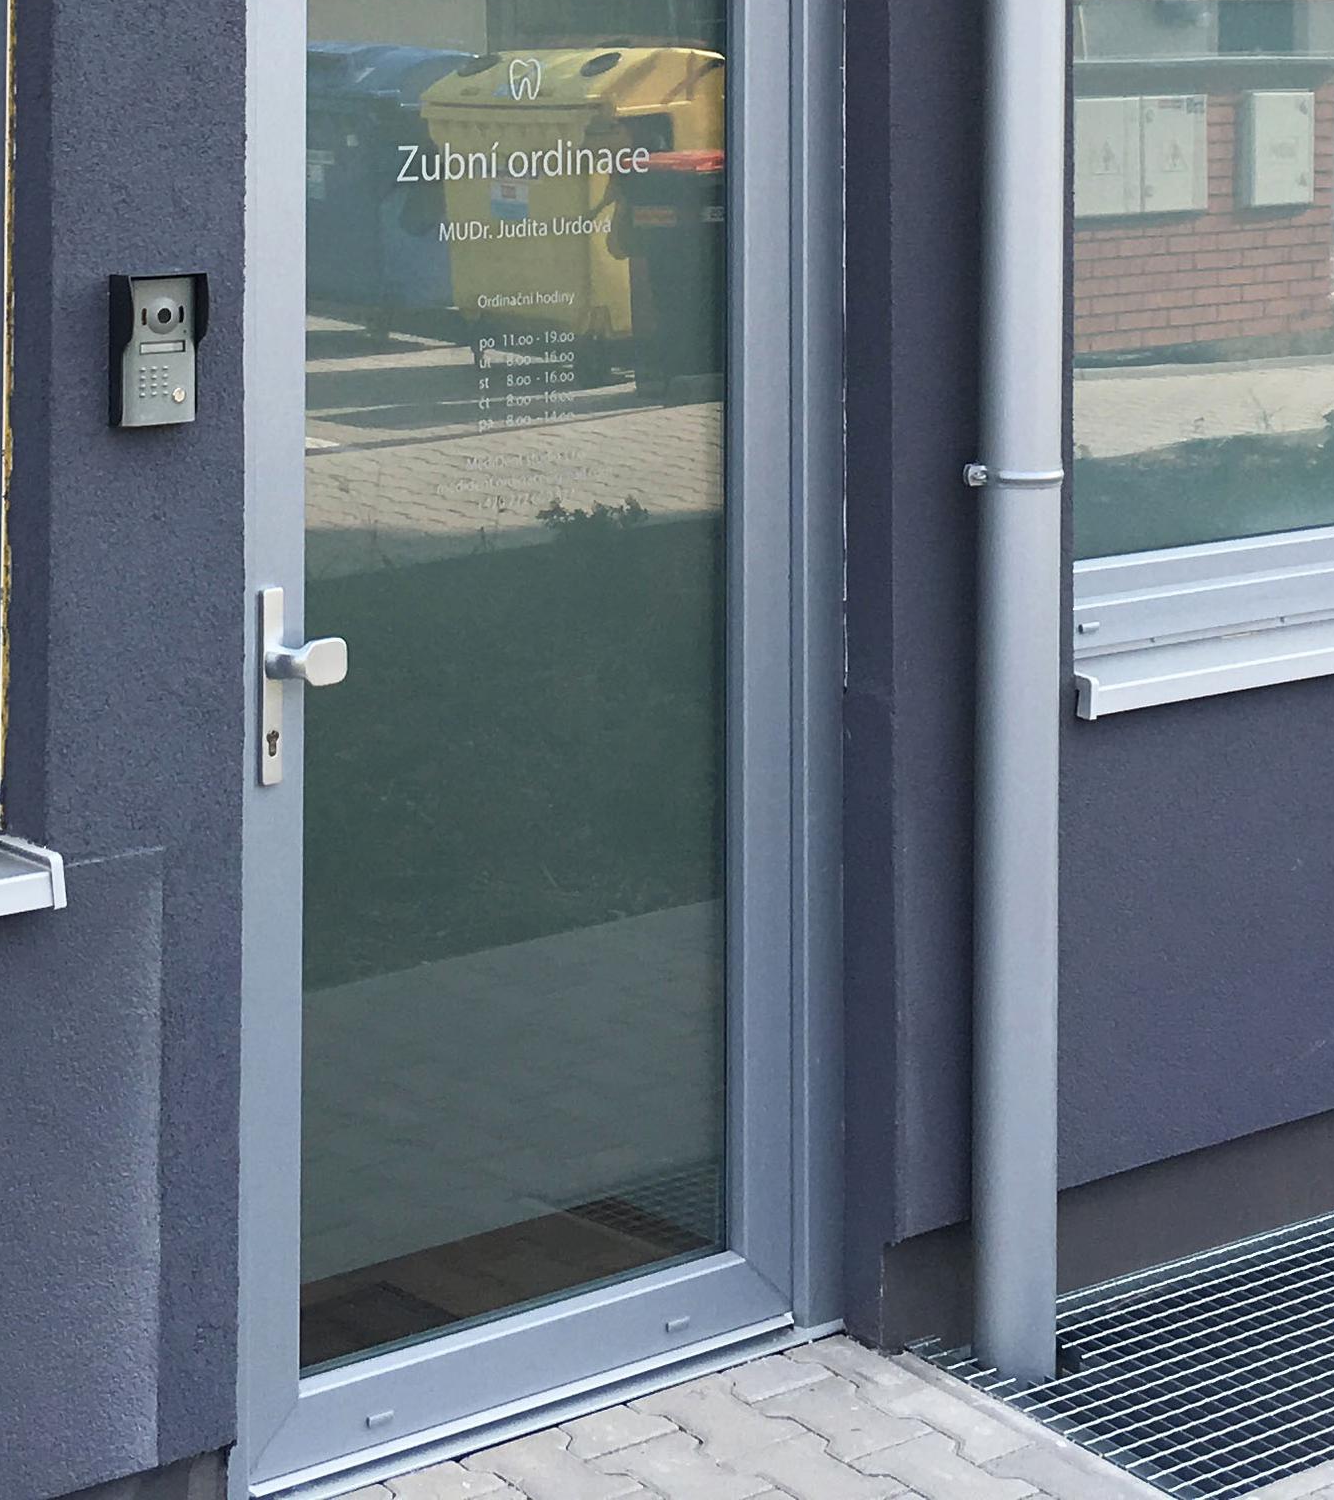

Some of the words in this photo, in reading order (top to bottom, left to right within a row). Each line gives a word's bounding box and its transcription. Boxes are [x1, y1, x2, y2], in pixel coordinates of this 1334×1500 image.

[396, 141, 499, 183] Zubní
[508, 139, 650, 179] ordinace
[439, 220, 493, 242] MUDr.
[497, 218, 548, 239] Judita
[553, 215, 612, 236] Urdová
[536, 290, 575, 306] hodiny
[479, 338, 495, 352] po
[502, 334, 533, 346] 11.00
[545, 331, 575, 343] 19.00
[545, 351, 575, 363] 16.00
[479, 377, 490, 389] st
[507, 374, 531, 387] 8.00
[545, 371, 575, 383] 16.00
[507, 393, 531, 407] 8.00
[506, 414, 531, 427] 8.00
